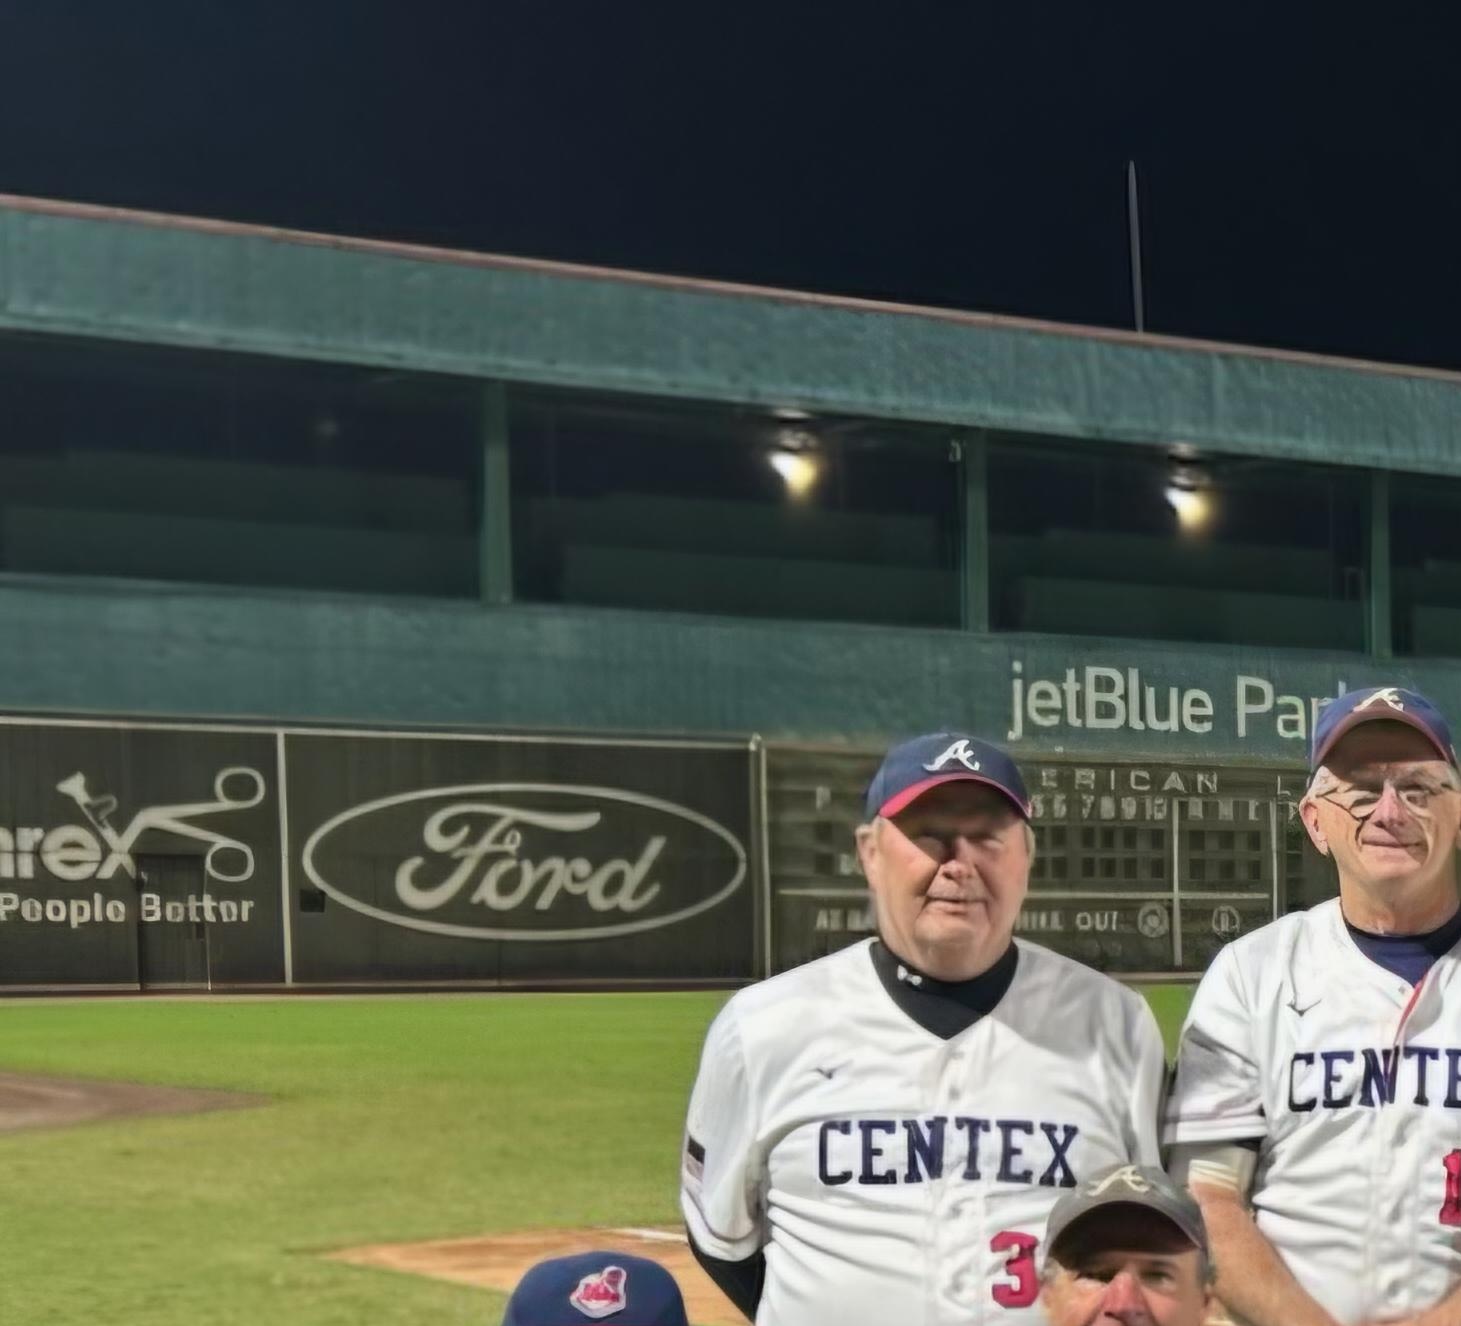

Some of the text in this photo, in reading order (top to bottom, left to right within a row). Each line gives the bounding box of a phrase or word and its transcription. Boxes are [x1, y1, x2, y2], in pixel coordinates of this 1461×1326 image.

[1007, 660, 1214, 741] jetBlue
[1042, 767, 1218, 794] ERICAN
[395, 803, 667, 912] Ford
[817, 1115, 1080, 1188] CENTEX
[989, 1230, 1040, 1309] 3
